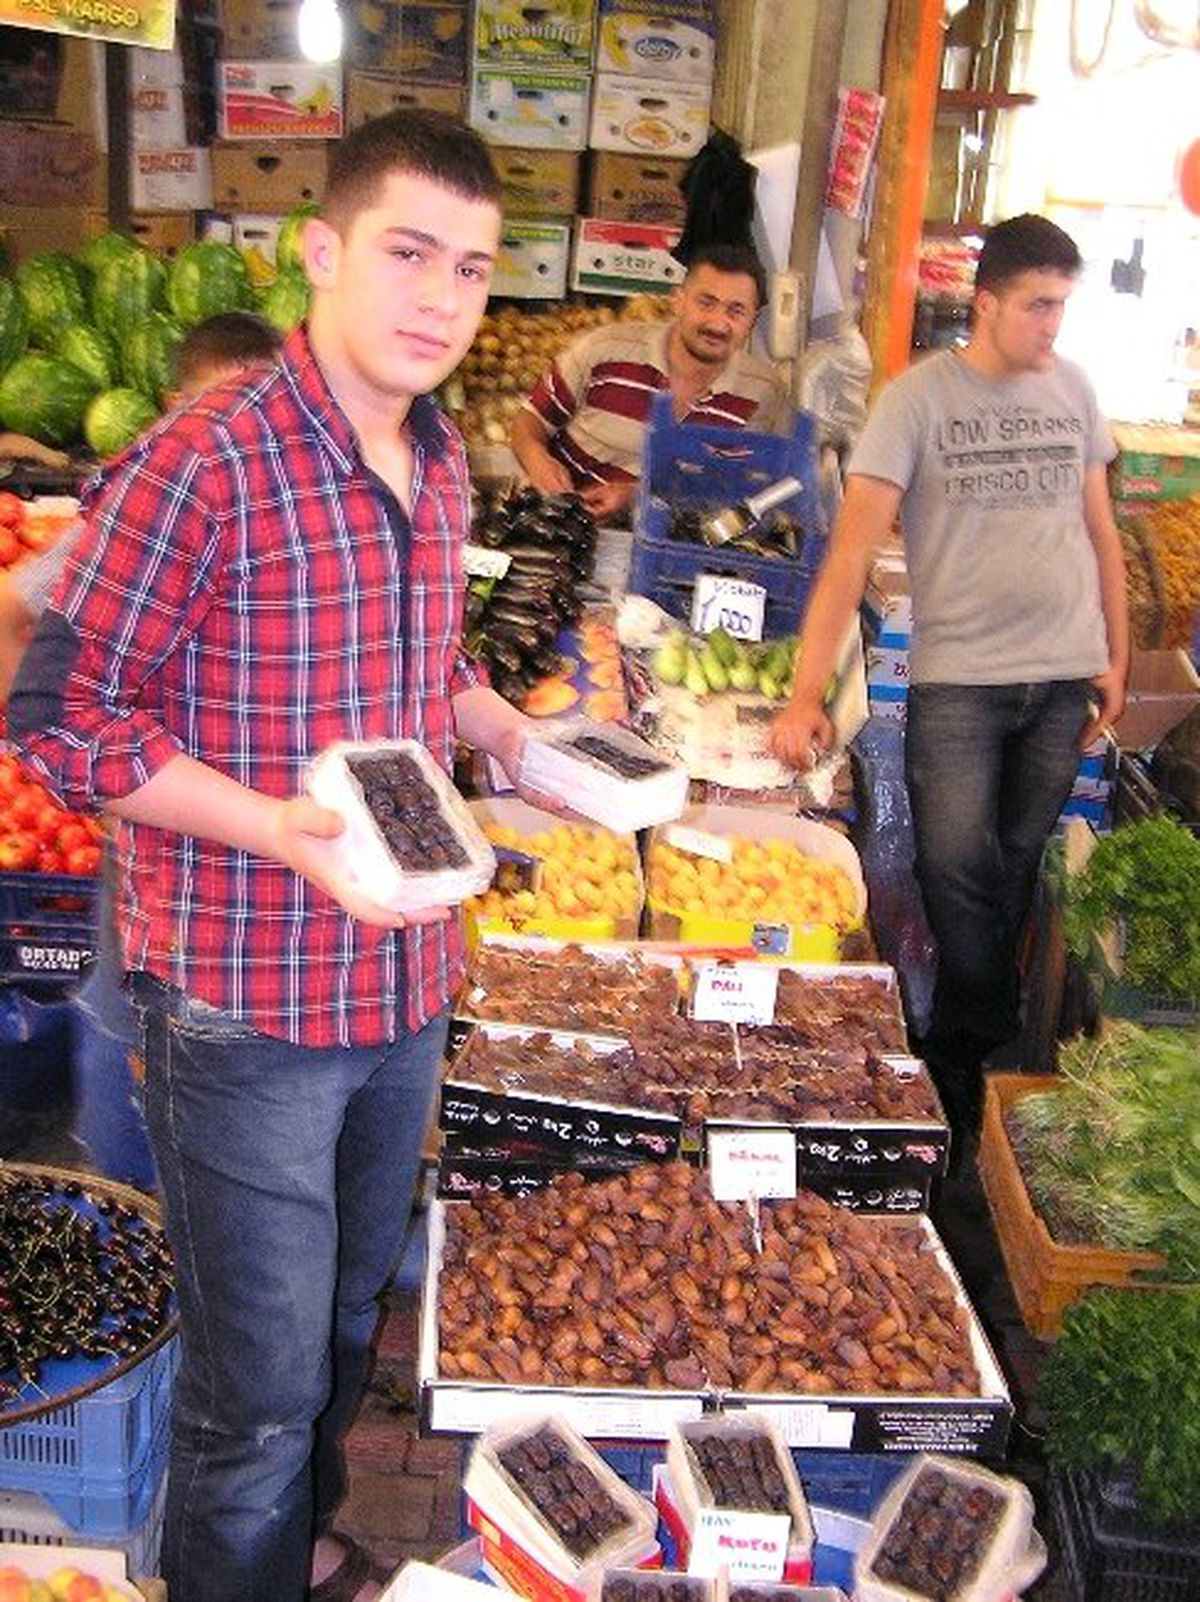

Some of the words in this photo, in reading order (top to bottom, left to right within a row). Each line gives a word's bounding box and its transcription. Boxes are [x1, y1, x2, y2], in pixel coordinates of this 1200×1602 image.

[65, 1, 139, 28] KARGO
[612, 252, 656, 270] star
[938, 419, 989, 451] LOW
[999, 417, 1083, 442] SPARKS
[945, 470, 1030, 494] FRISCO
